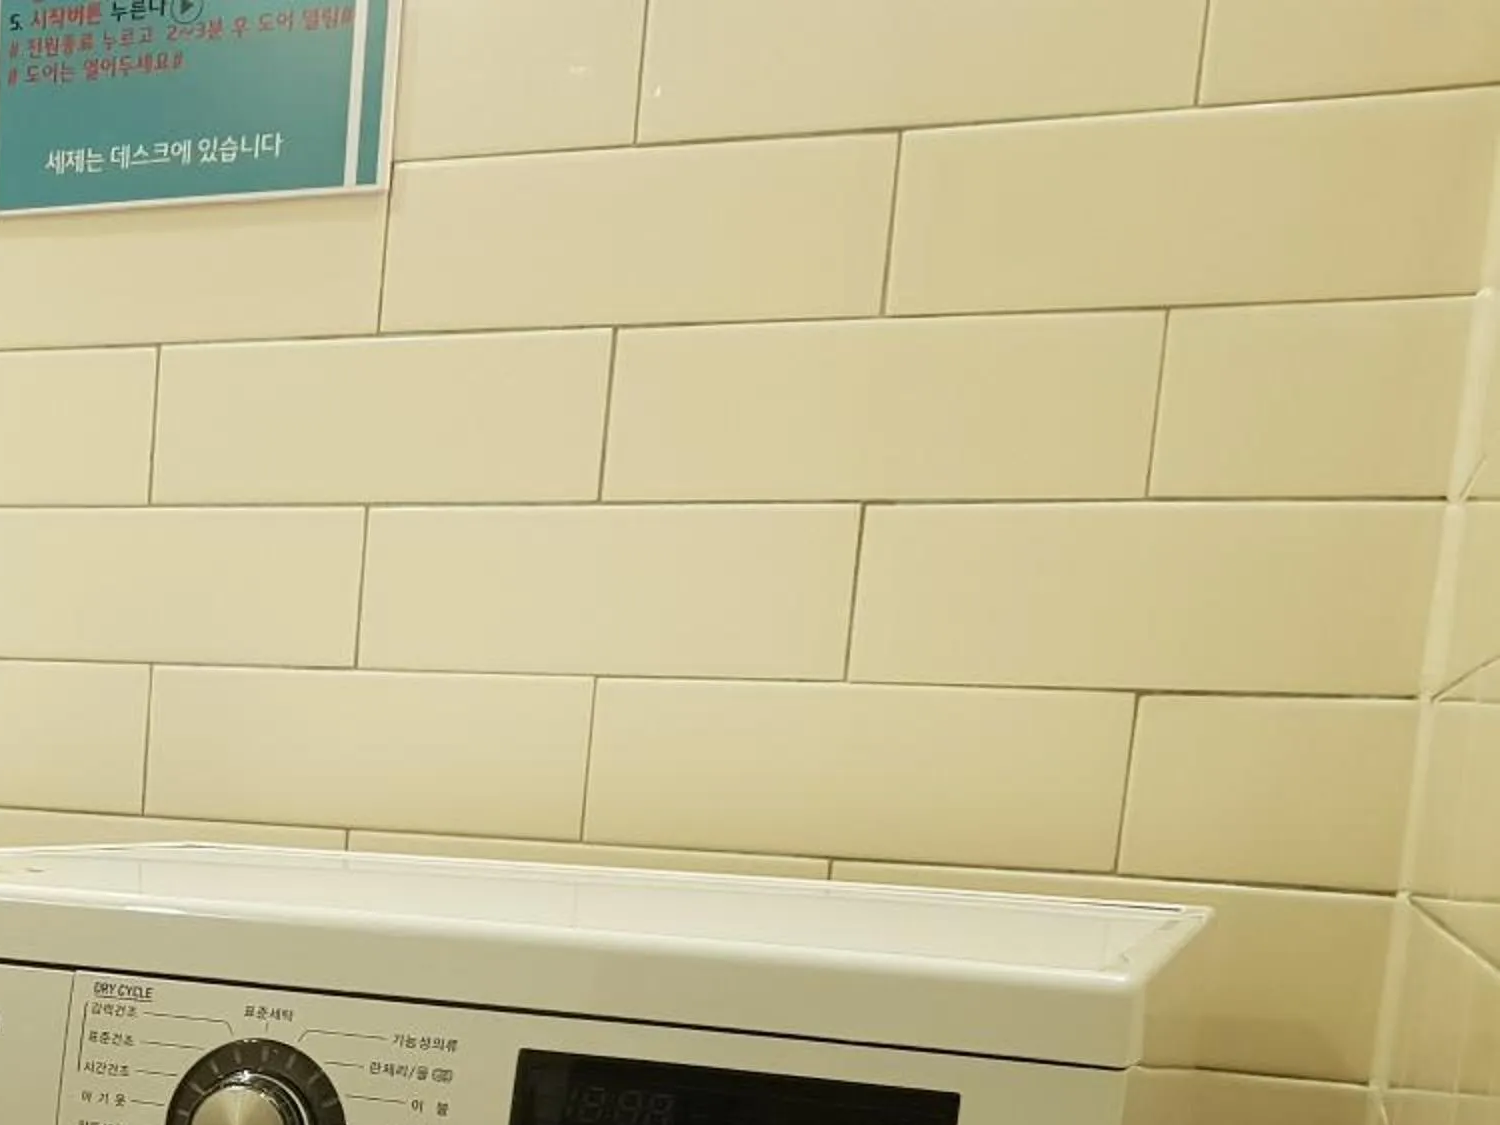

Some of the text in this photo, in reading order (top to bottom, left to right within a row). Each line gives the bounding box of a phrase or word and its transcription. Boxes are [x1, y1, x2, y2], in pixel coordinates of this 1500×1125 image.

[103, 26, 153, 51] 누르고
[232, 16, 250, 38] 후
[258, 11, 294, 32] 도어
[25, 61, 75, 84] 도어는
[45, 132, 284, 175] 세제는 데스크에 있습니다
[117, 983, 154, 999] CYCLE
[244, 1005, 293, 1022] 표준세탁
